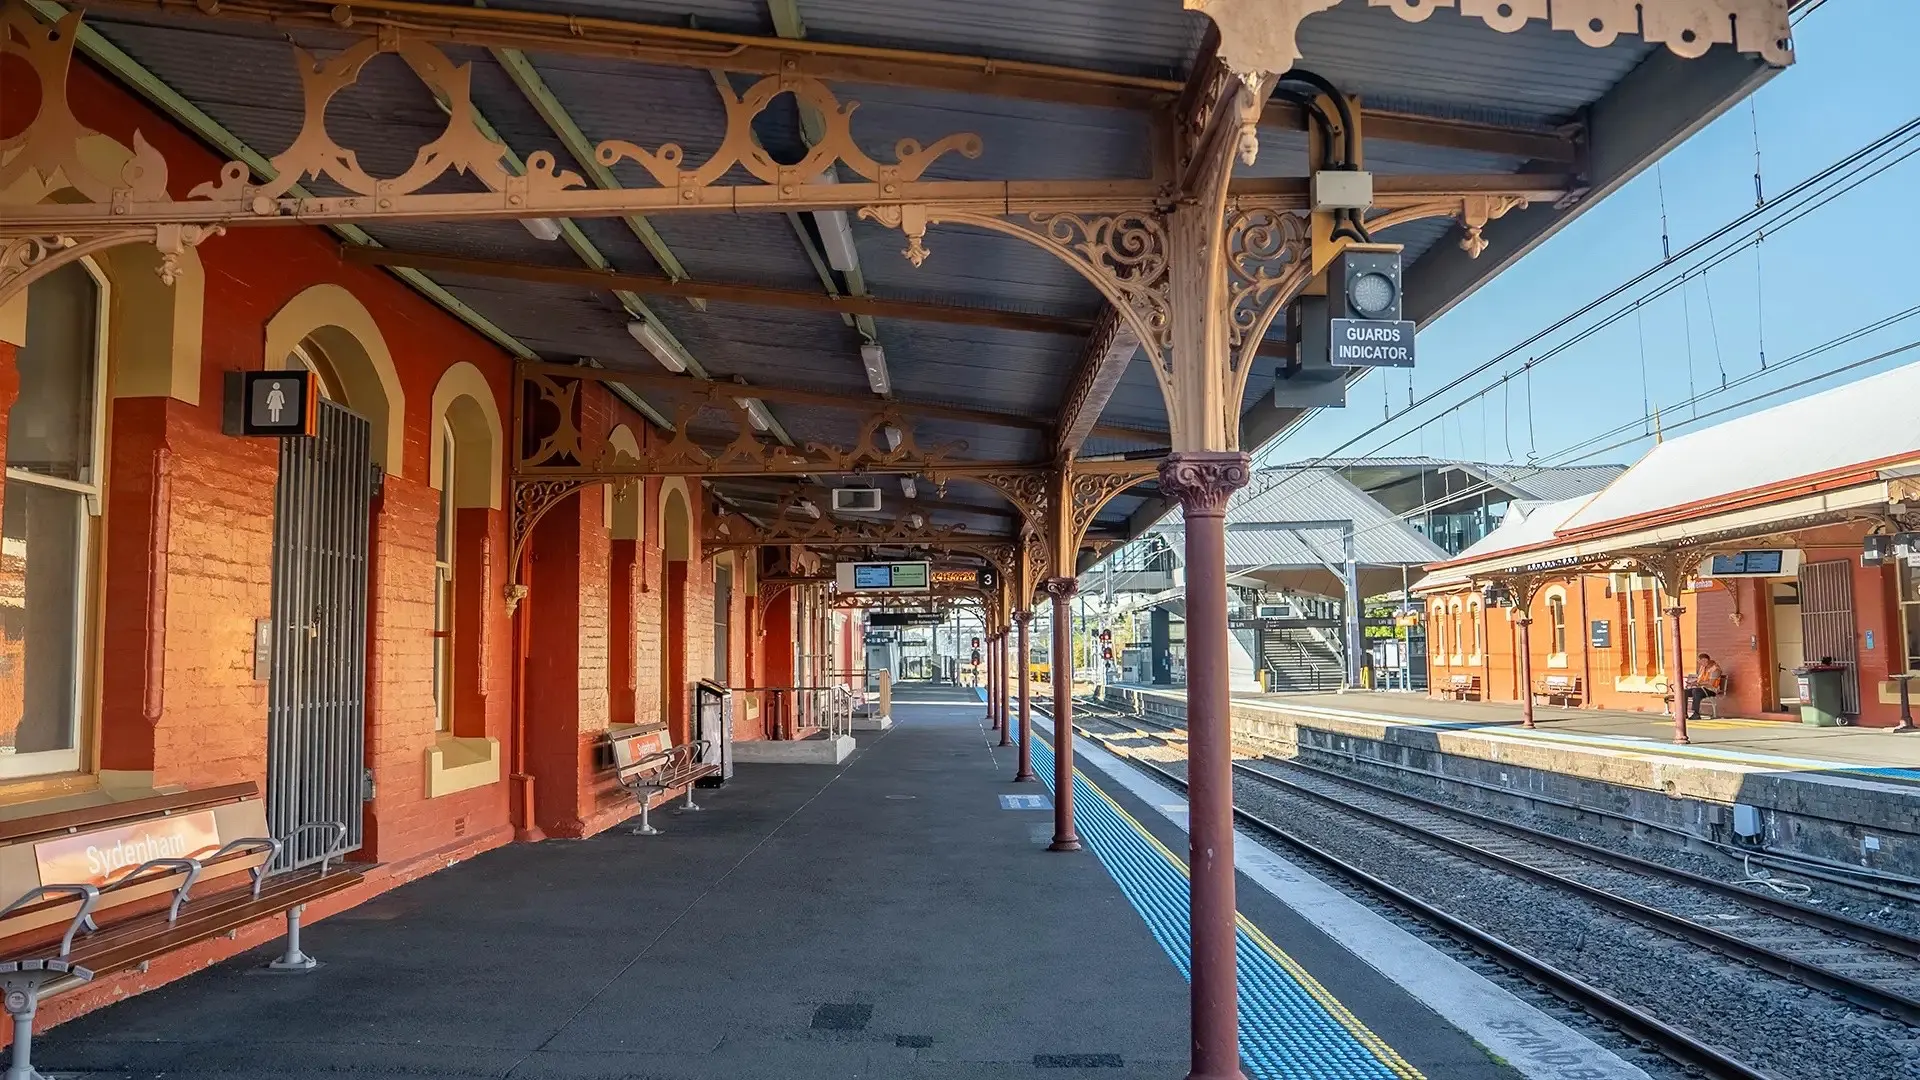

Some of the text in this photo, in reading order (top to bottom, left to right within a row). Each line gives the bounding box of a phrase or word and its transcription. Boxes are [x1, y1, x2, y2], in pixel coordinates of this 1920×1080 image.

[1346, 327, 1401, 342] GUARDS
[1339, 345, 1407, 360] INDICATOR
[984, 574, 992, 585] 3
[86, 833, 185, 879] Sydenham
[1485, 1019, 1583, 1067] STAND
